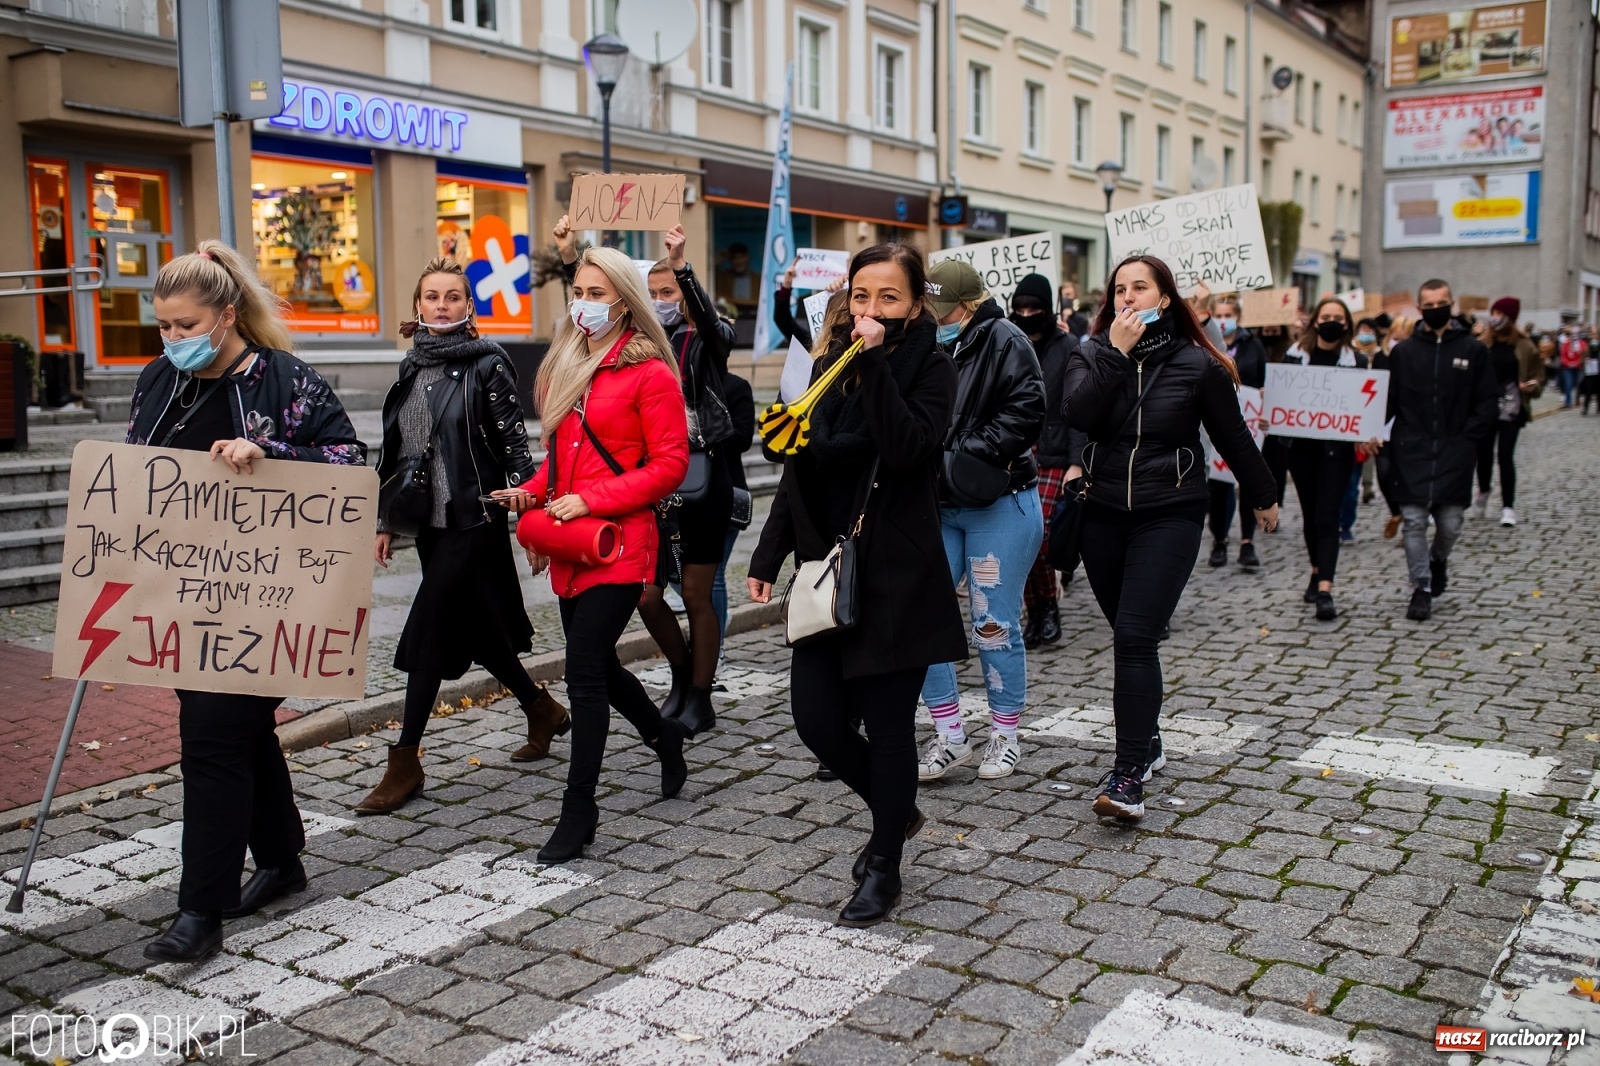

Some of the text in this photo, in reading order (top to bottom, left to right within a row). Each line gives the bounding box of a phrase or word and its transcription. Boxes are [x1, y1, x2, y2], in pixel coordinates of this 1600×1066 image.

[270, 83, 468, 150] ZDROWIT
[1395, 101, 1536, 123] ALEXANDER
[1114, 205, 1165, 236] MARS
[1176, 202, 1197, 219] OD
[1183, 213, 1233, 237] SRAM
[991, 240, 1051, 267] PRECZ
[1178, 243, 1253, 270] W DUPĘ
[980, 265, 1036, 288] OJE
[1175, 264, 1265, 291] EBANY ELO
[84, 453, 117, 514] A
[176, 577, 250, 614] FAJNY
[127, 607, 367, 678] JA TEŻ NIE!
